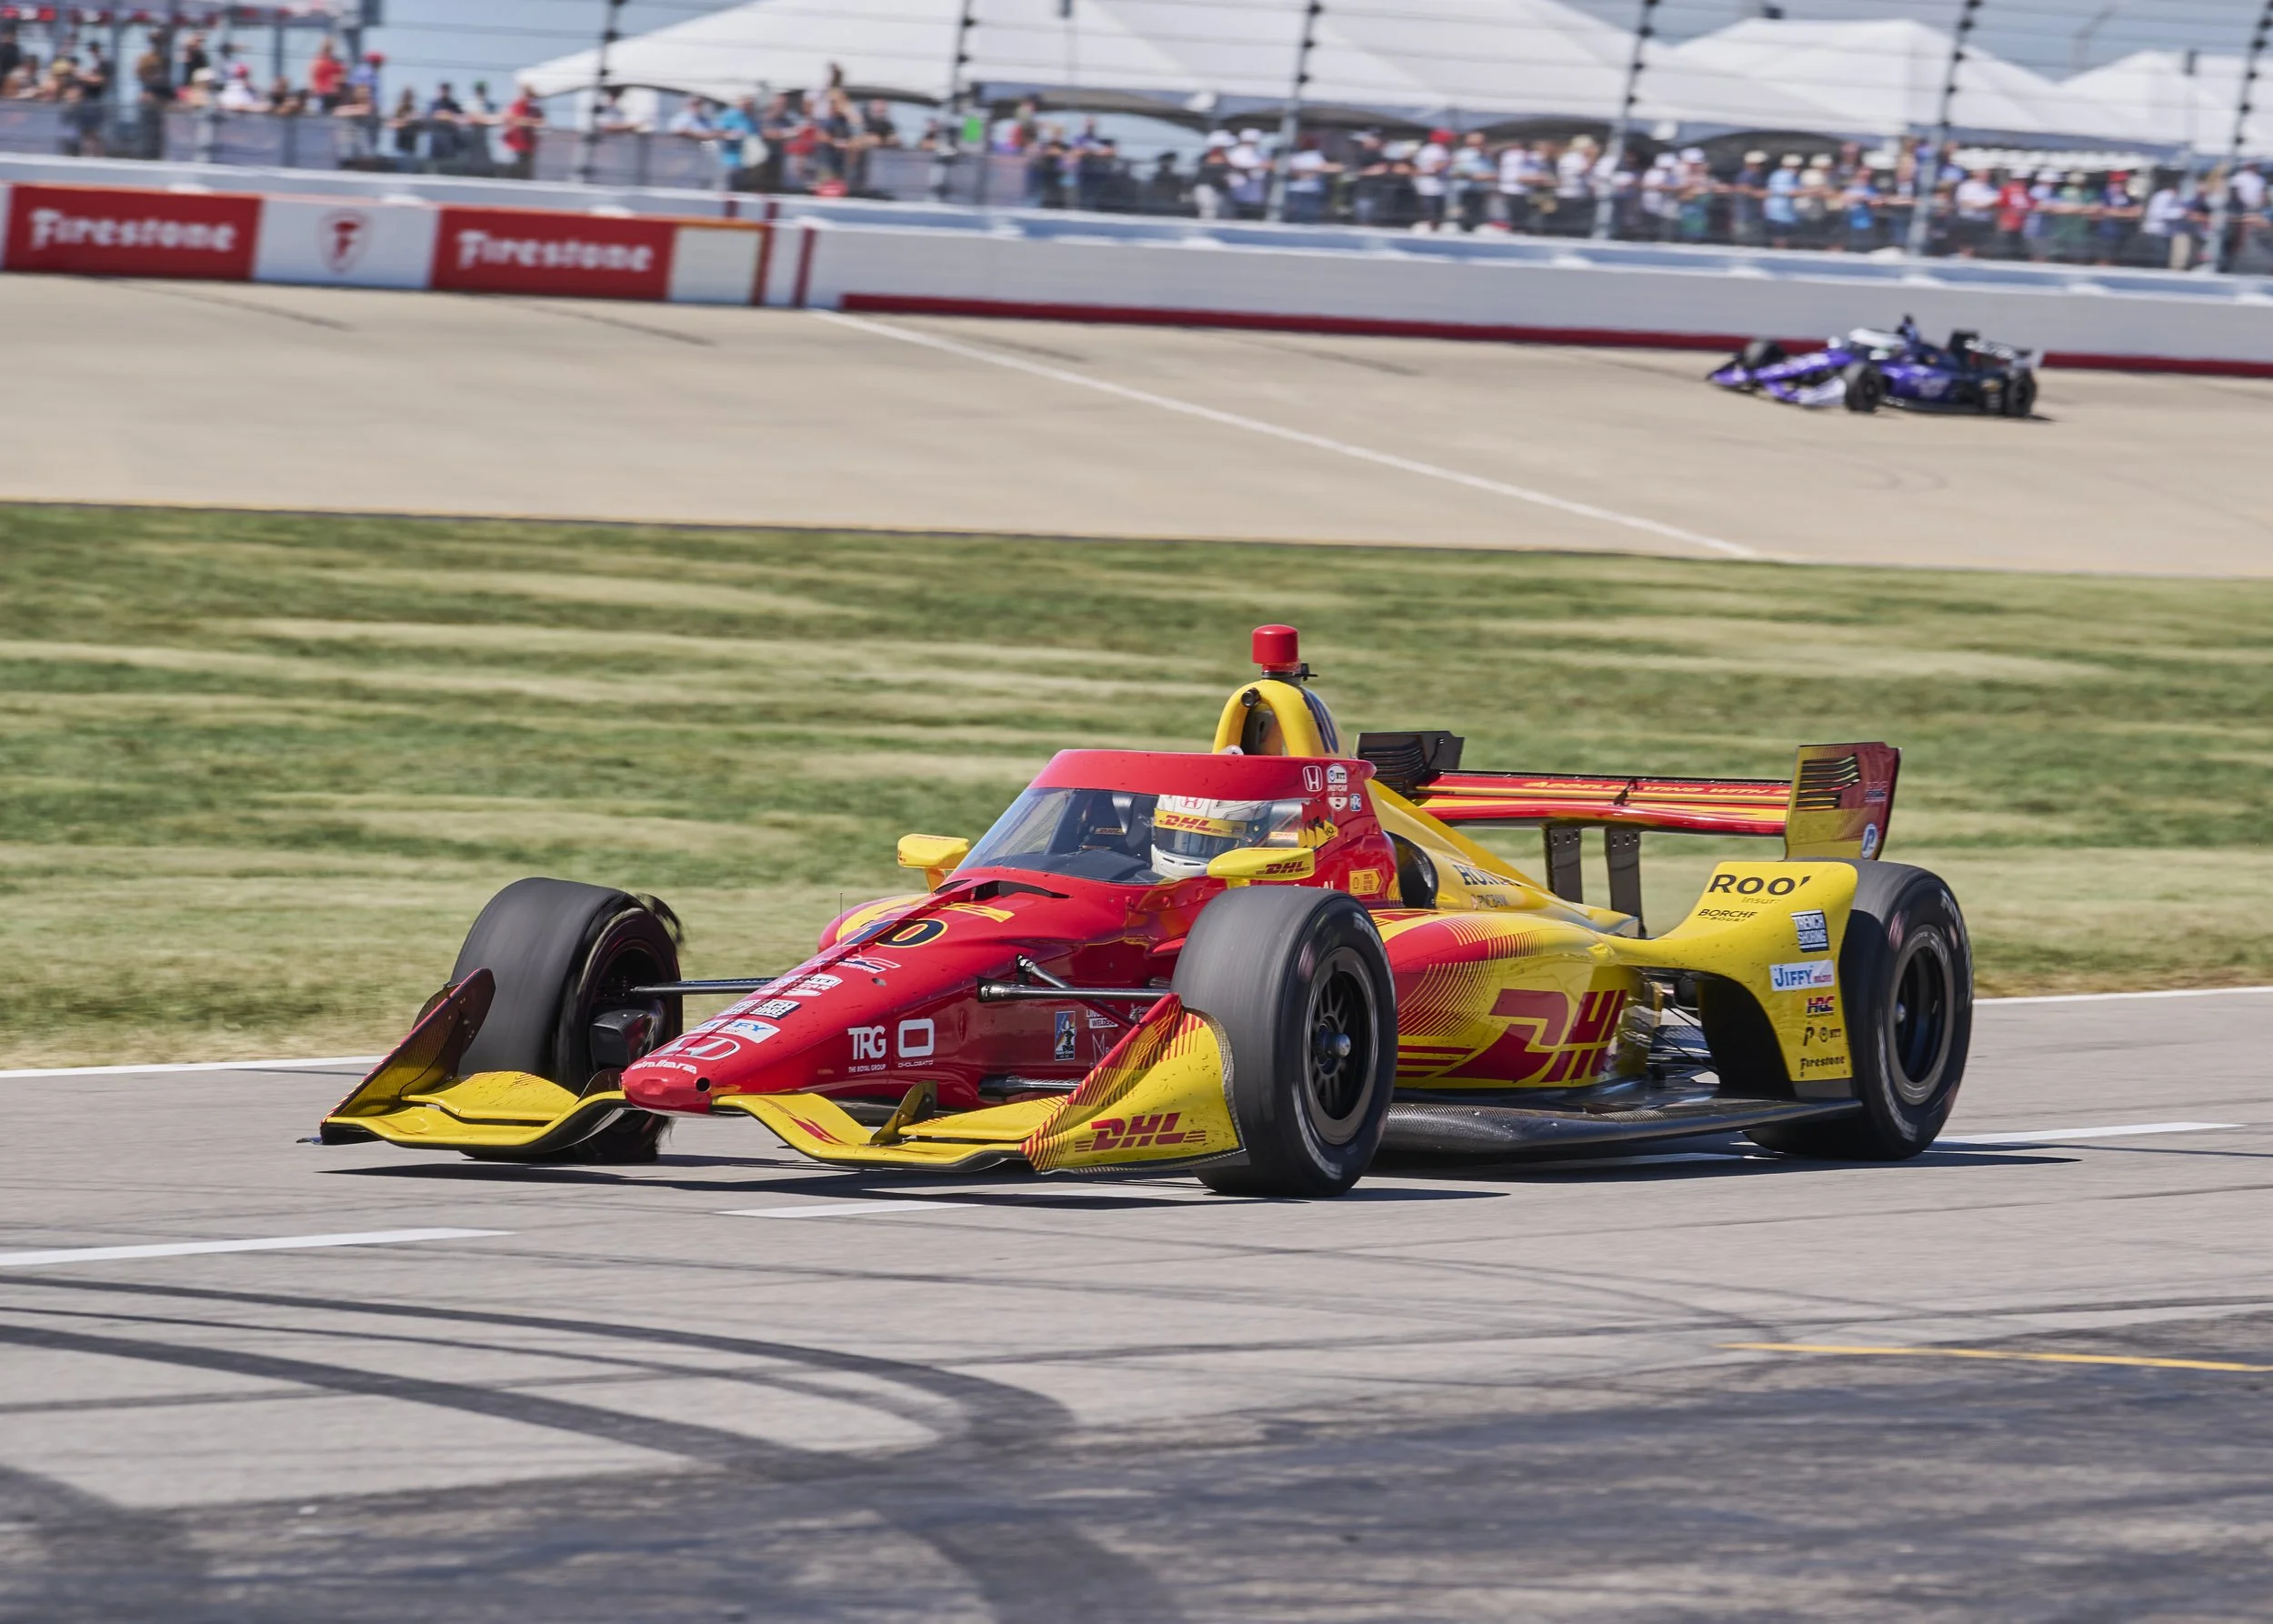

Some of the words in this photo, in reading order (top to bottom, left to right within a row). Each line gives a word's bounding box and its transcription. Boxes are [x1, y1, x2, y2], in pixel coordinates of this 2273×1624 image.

[30, 207, 237, 252] Firestone
[457, 228, 654, 272] Firestone
[1163, 814, 1214, 832] DHL
[1265, 861, 1306, 874] DHL
[1774, 967, 1812, 987] JIFFY
[1807, 995, 1835, 1014] HRC
[847, 1025, 886, 1060] TRG
[631, 1059, 697, 1075] dallara
[871, 1063, 886, 1071] GROUP
[1799, 1056, 1846, 1071] Firestone
[1090, 1112, 1186, 1152] DHL
